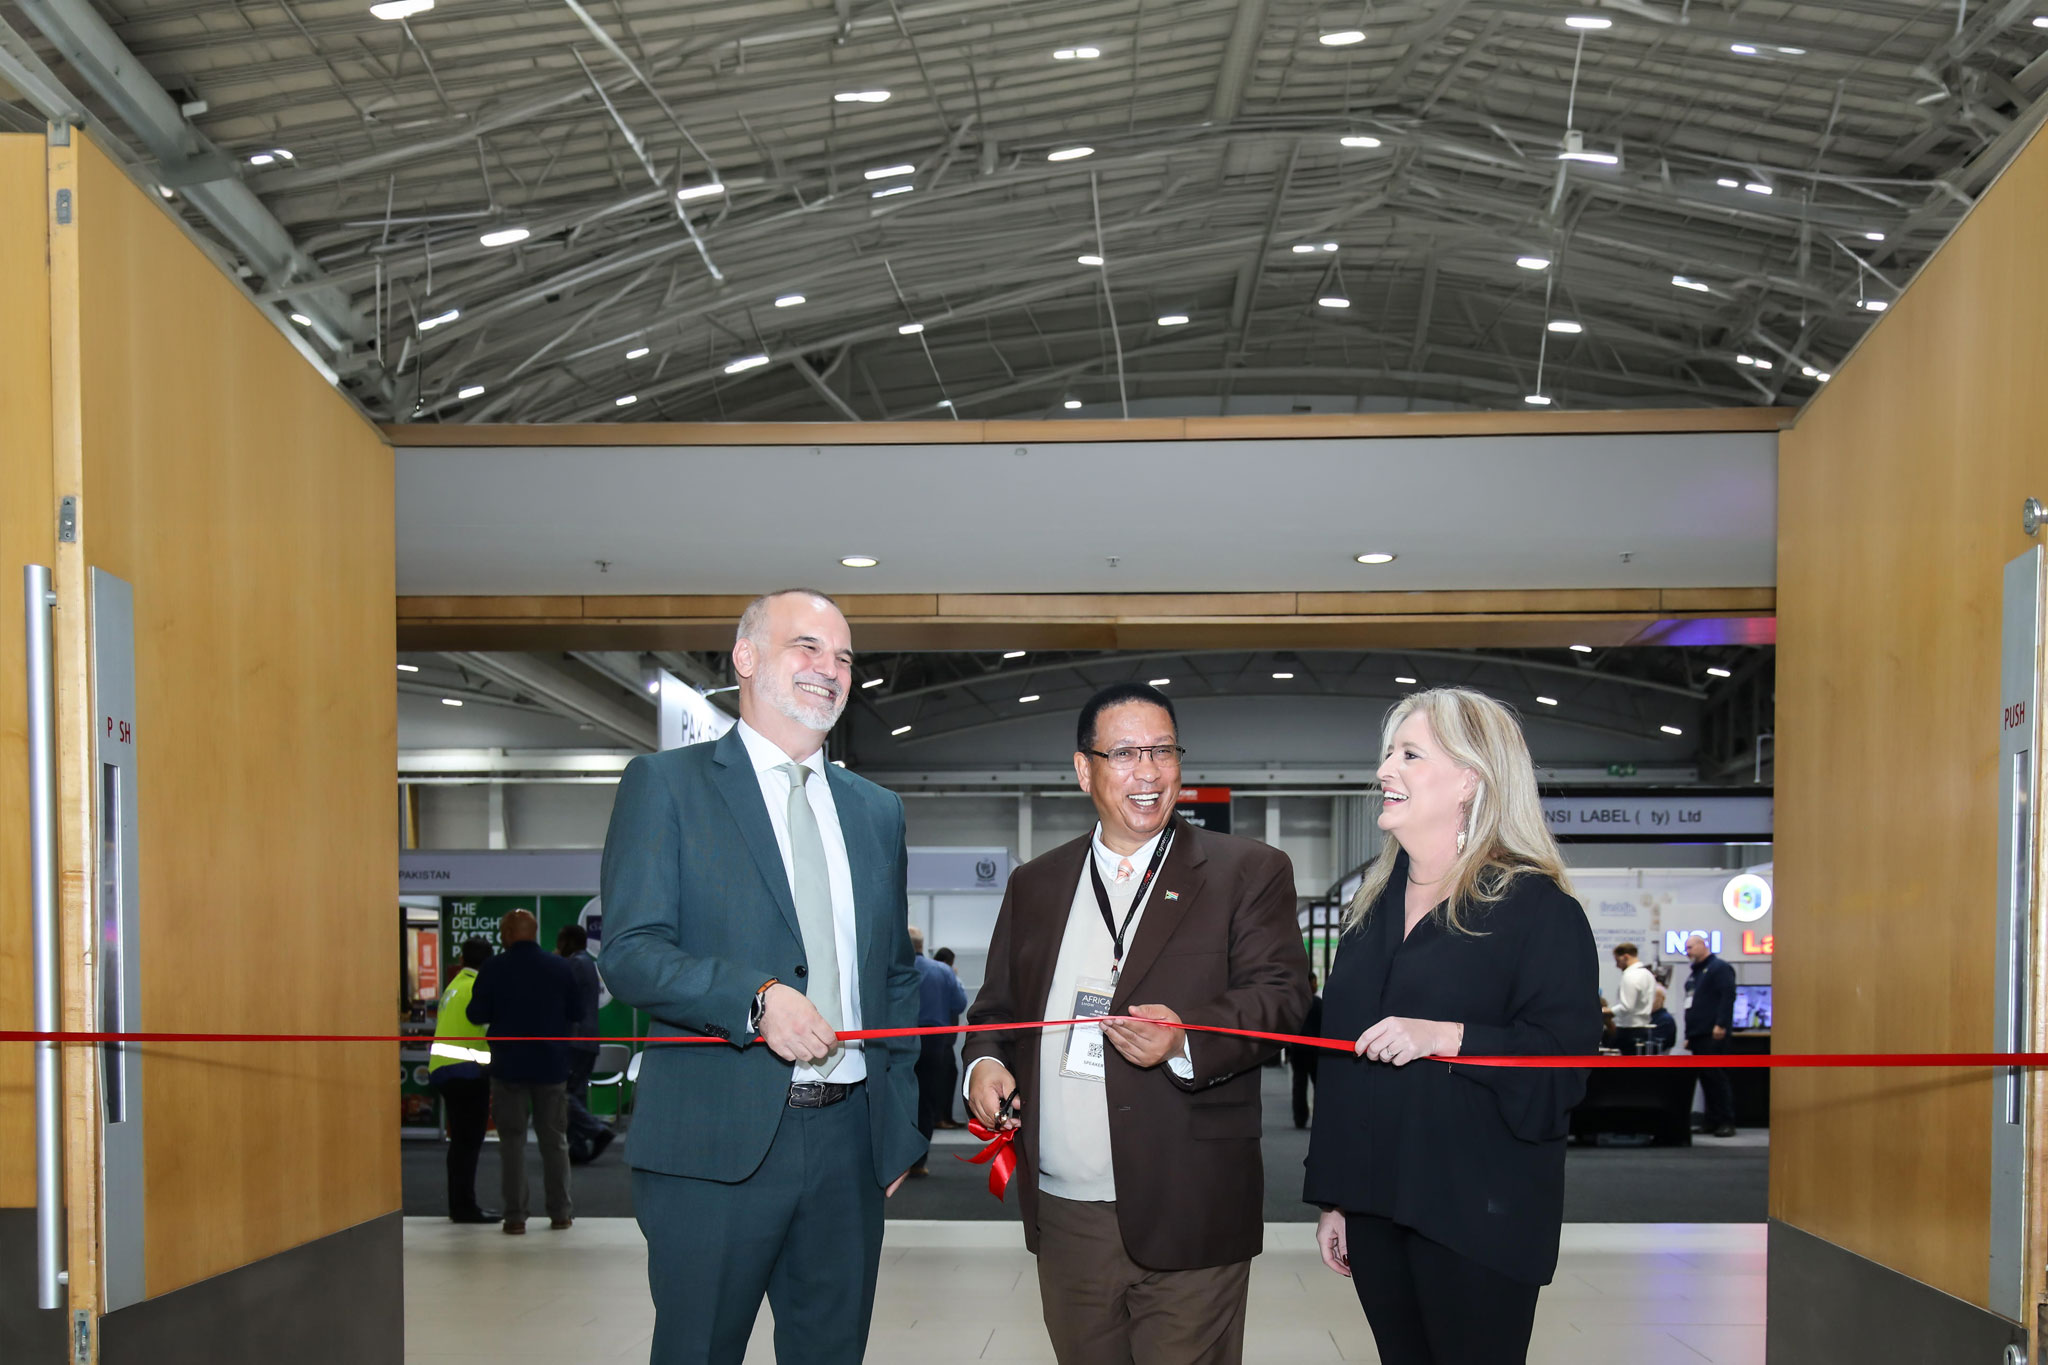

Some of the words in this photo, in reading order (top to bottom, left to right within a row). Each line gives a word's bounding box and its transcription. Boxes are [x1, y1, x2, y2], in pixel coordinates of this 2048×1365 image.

[2004, 701, 2025, 731] PUSH
[107, 716, 131, 745] PSH
[1544, 809, 1571, 823] NSI
[1581, 809, 1630, 823] LABEL
[1678, 809, 1702, 823] Ltd
[399, 870, 450, 880] PAKISTAN
[451, 902, 477, 915] THE
[452, 917, 502, 930] DELIGH
[1081, 994, 1111, 1006] AFRICA
